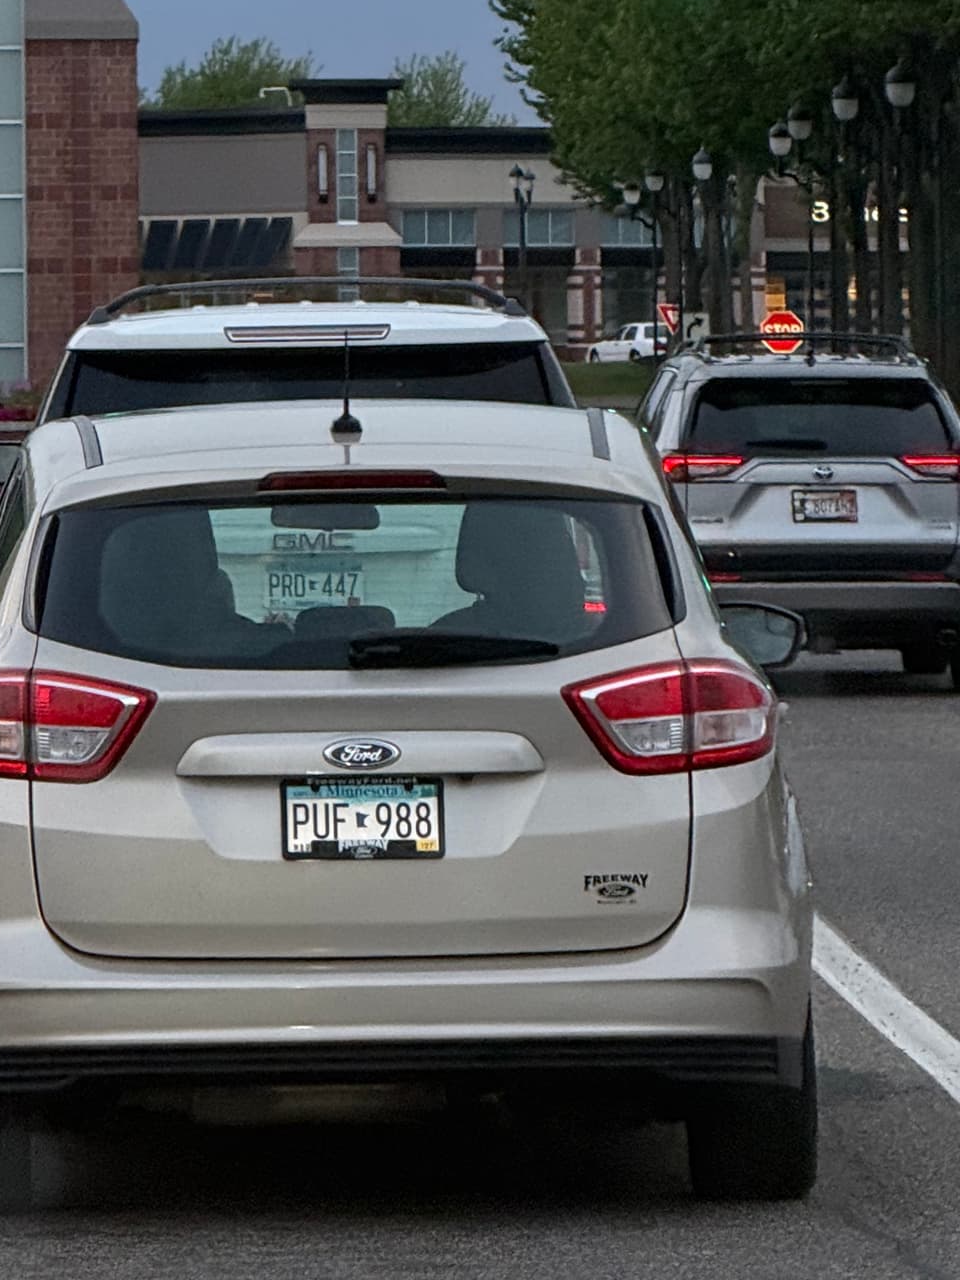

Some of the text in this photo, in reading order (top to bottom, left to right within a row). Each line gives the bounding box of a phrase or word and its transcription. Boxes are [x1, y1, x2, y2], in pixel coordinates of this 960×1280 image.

[273, 533, 354, 551] GMC
[322, 573, 358, 597] 447
[340, 744, 381, 762] Ford
[326, 785, 399, 797] Minnesota
[292, 802, 432, 839] PUF 988
[584, 874, 648, 891] FREEWAY
